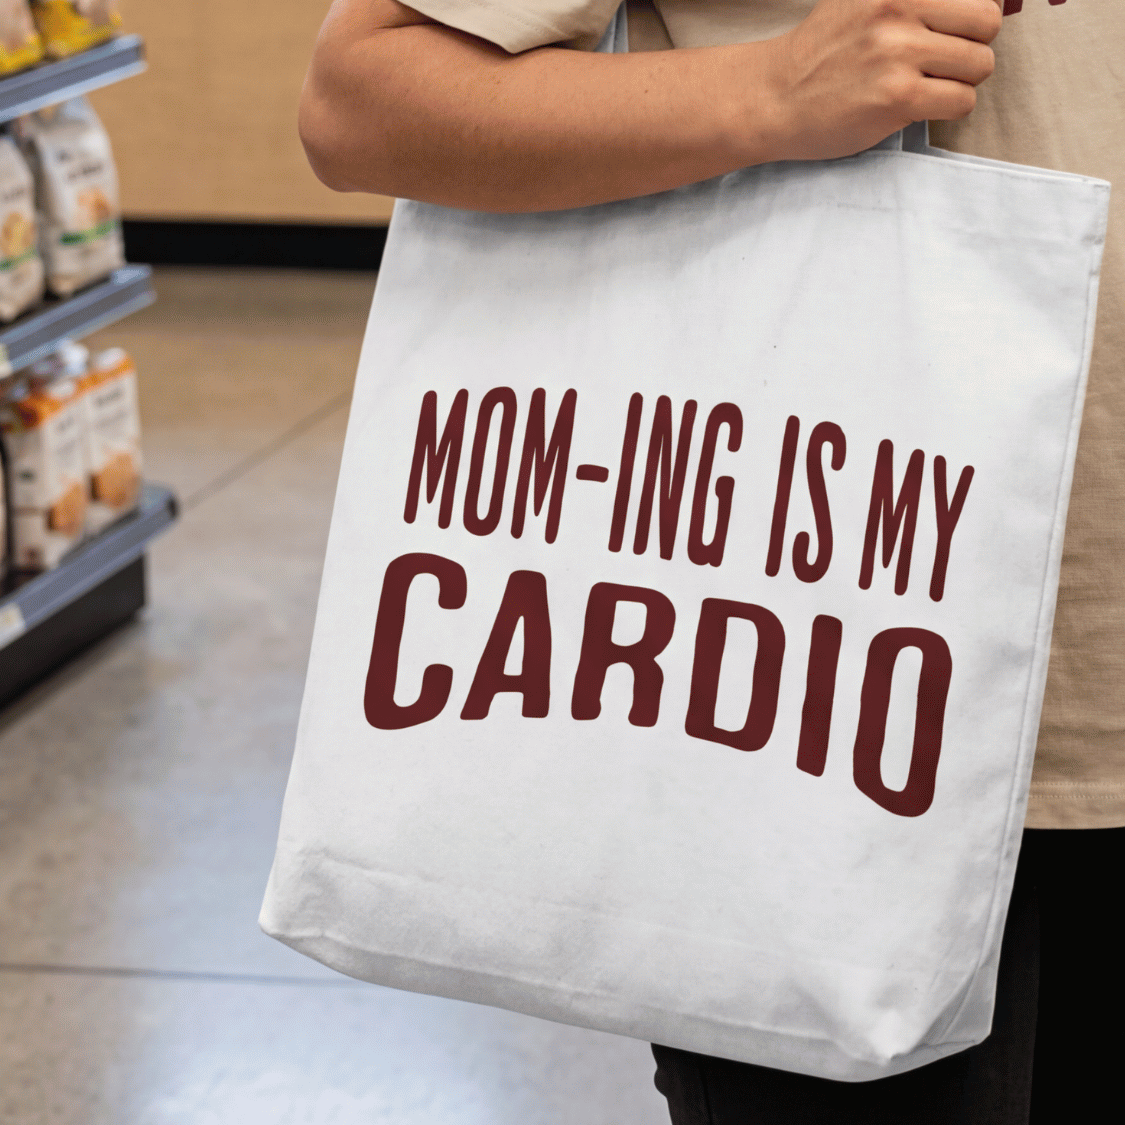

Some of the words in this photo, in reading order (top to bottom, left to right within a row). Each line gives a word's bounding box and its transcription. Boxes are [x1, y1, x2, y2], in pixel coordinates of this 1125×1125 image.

[403, 386, 744, 568] MOM-ING
[765, 415, 847, 584] IS
[858, 438, 976, 603] MY
[363, 552, 954, 818] CARDIO
